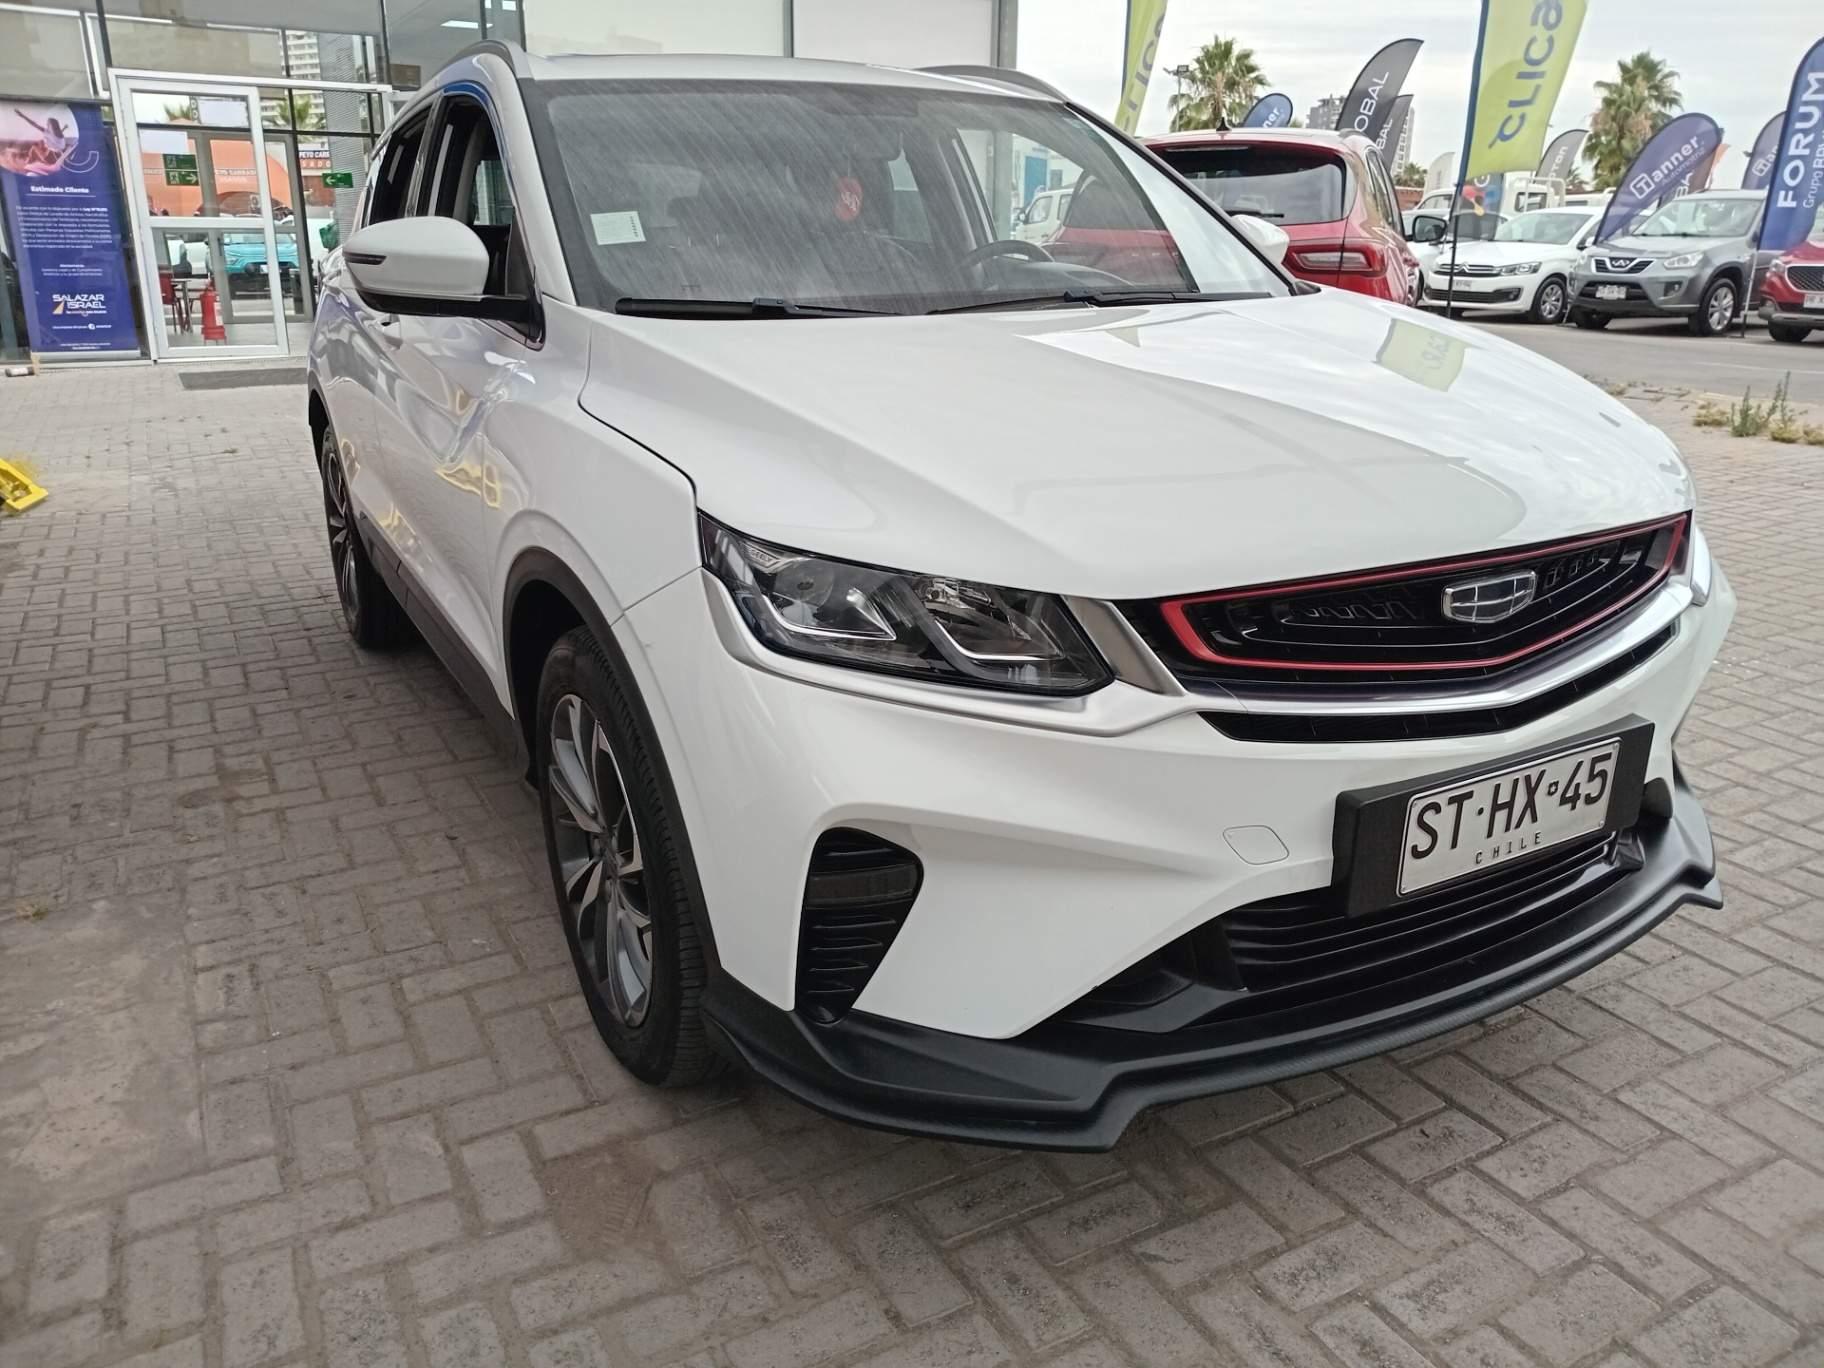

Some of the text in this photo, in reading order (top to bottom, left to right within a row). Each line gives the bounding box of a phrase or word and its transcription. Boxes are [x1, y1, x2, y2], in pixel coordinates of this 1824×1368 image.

[1776, 72, 1824, 208] FORUM
[1630, 136, 1699, 199] Tanner
[1802, 170, 1824, 208] Grupo
[52, 294, 105, 302] SALAZAR
[66, 301, 106, 309] ISRAEL
[1475, 831, 1541, 864] CHILE
